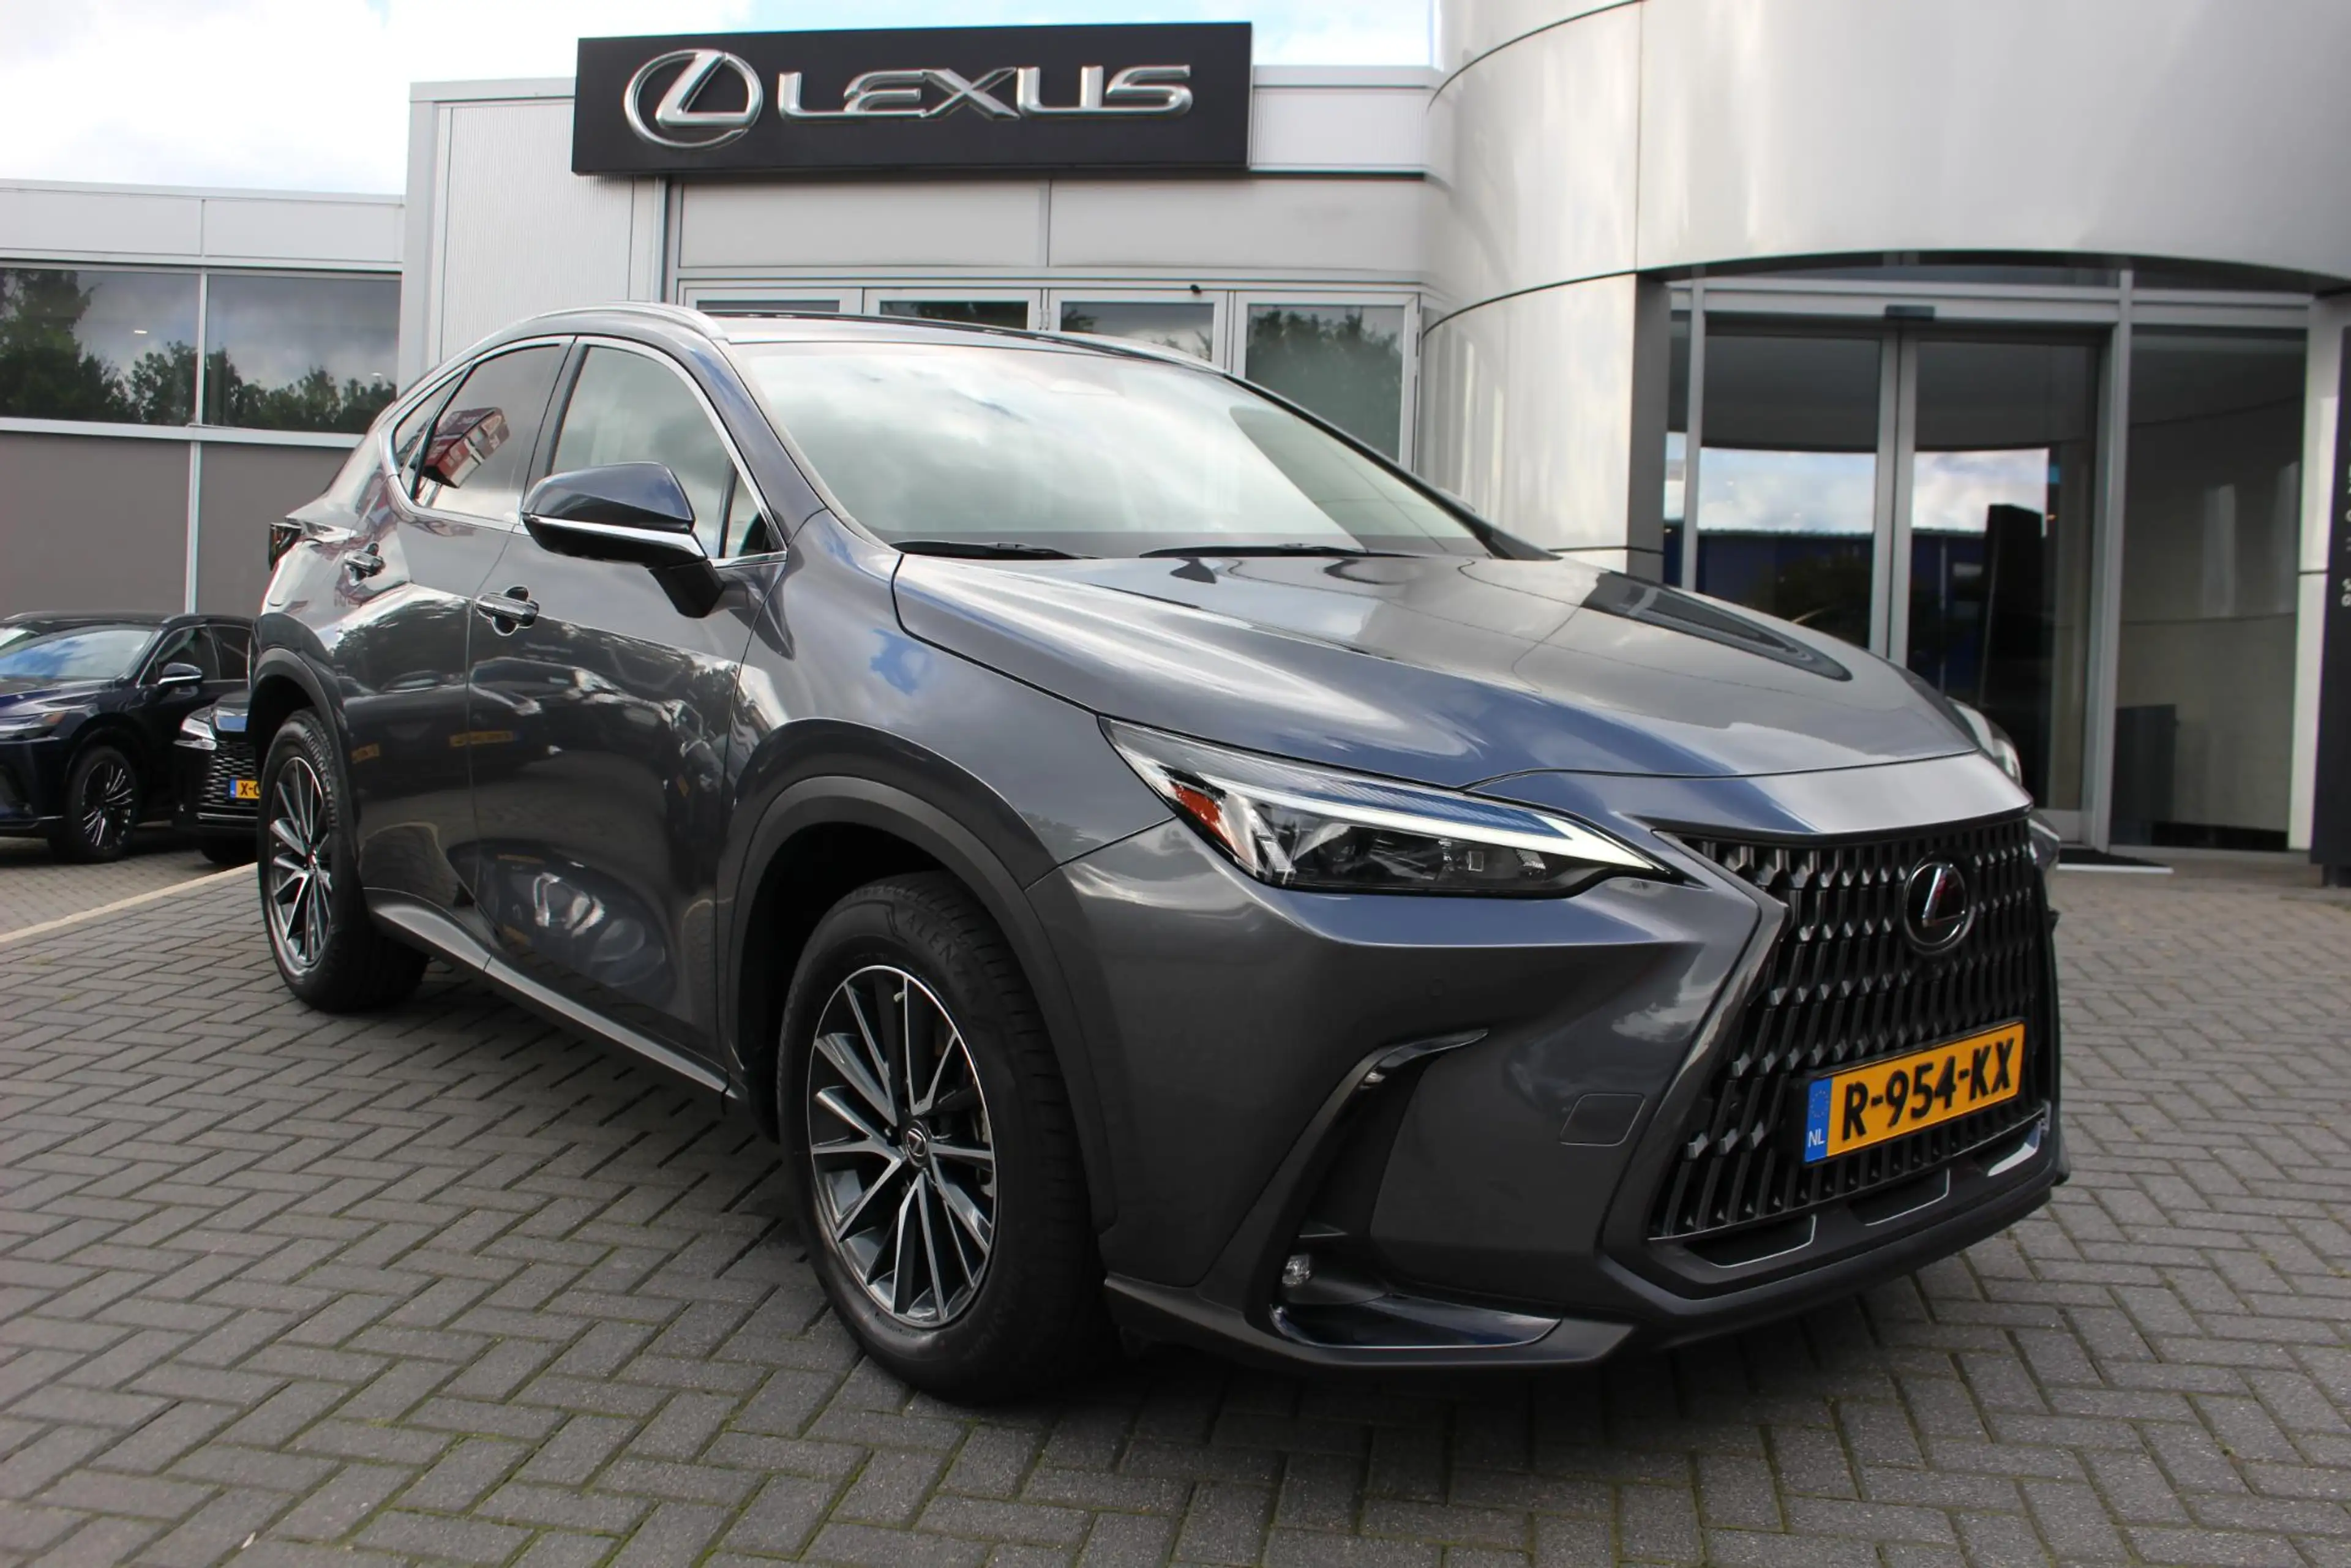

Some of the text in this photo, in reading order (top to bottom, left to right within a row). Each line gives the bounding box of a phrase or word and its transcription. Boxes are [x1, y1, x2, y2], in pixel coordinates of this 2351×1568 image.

[778, 64, 1193, 121] LEXUS
[1842, 1037, 2015, 1141] R-954-KX
[1808, 1128, 1825, 1148] NL
